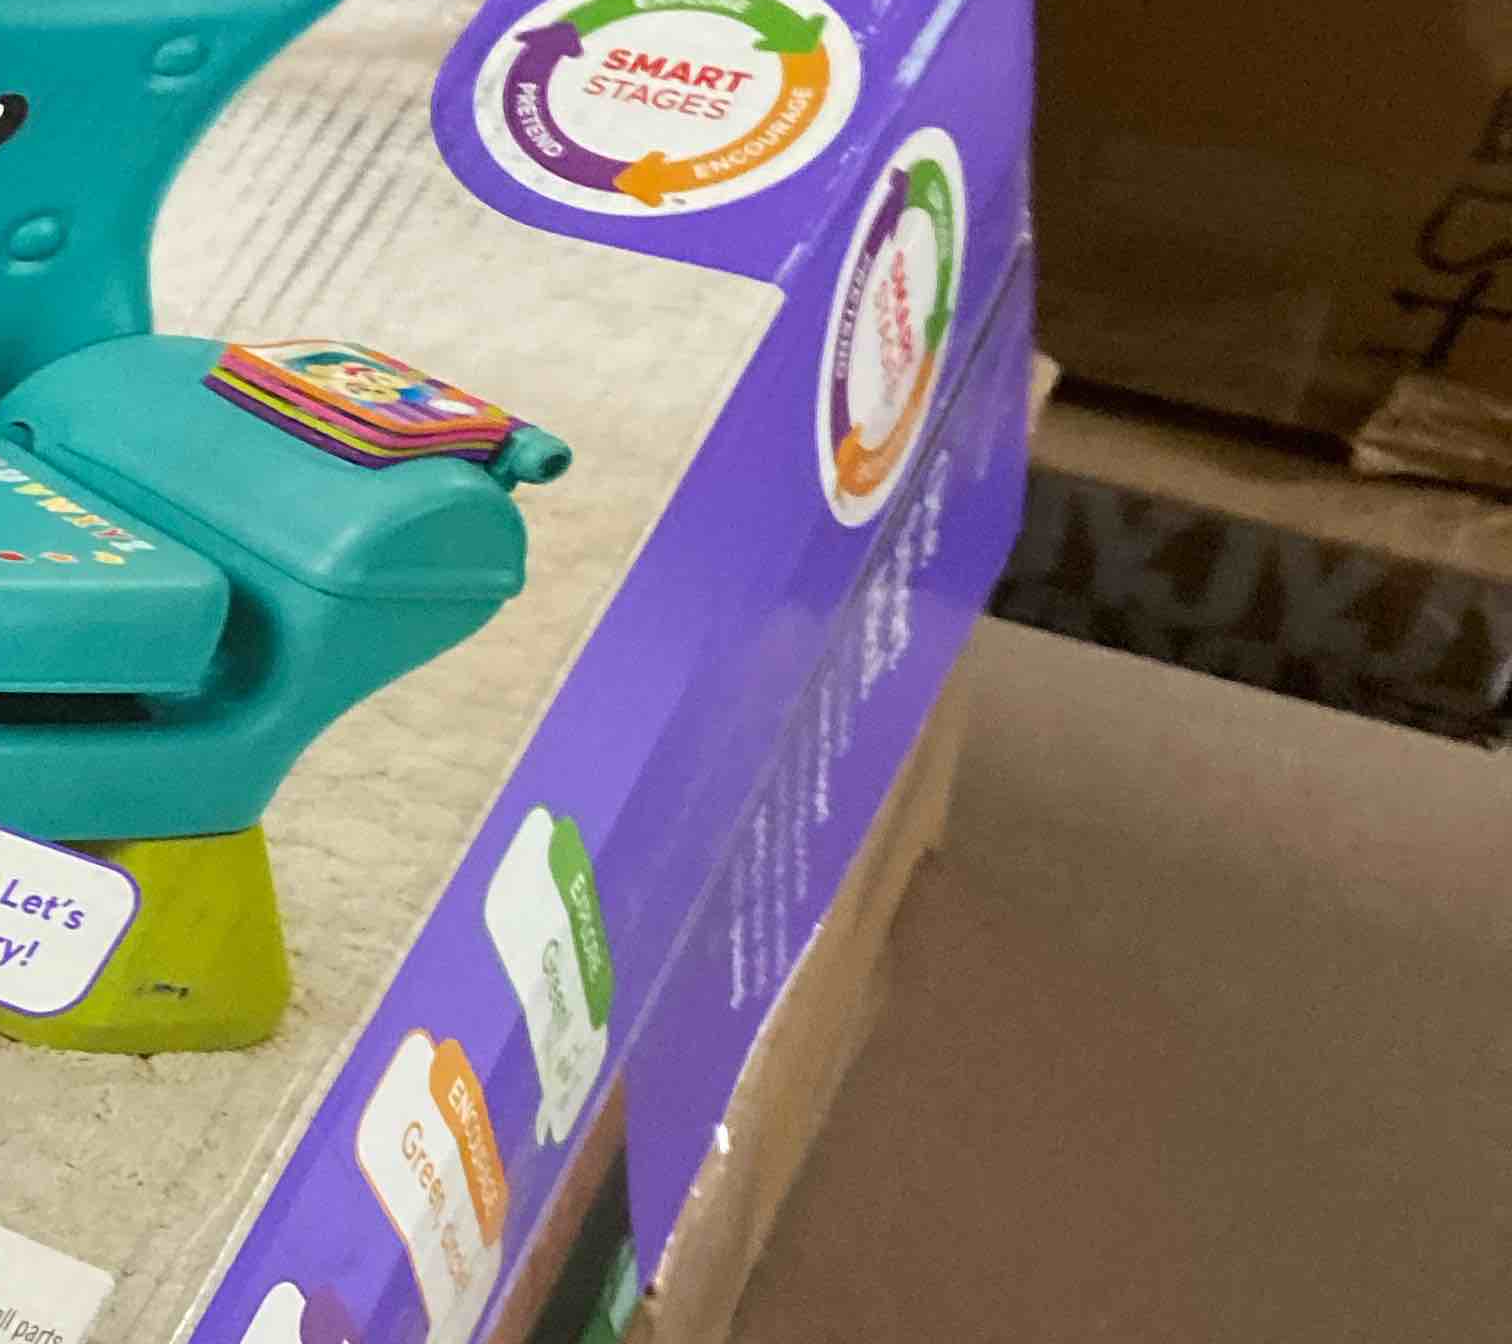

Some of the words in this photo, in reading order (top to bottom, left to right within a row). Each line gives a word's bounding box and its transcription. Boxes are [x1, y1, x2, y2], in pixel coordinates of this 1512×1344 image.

[582, 74, 732, 121] STAGES
[600, 47, 753, 94] SMART
[517, 81, 565, 158] PRETEND
[692, 87, 815, 180] ENCOURAGE
